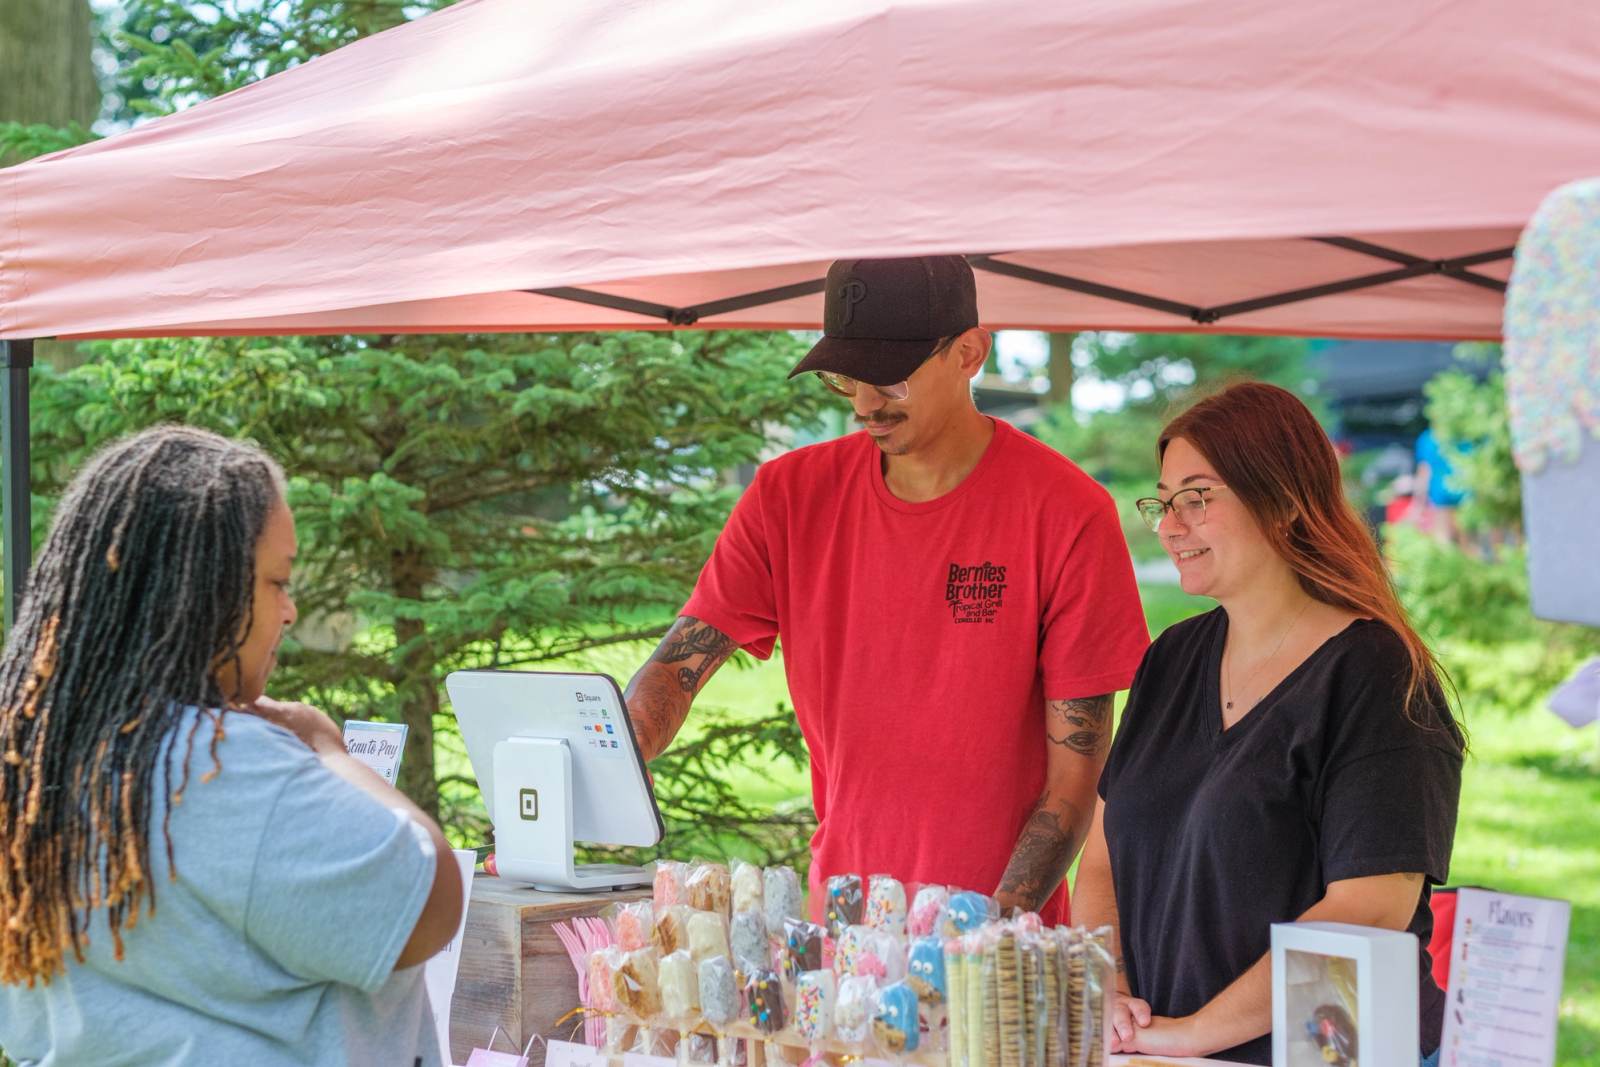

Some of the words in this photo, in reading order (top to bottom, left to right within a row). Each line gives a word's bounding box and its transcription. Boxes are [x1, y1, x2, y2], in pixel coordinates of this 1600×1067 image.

[945, 583, 1007, 600] Brother
[966, 609, 980, 617] and
[982, 608, 997, 617] Bar
[346, 738, 368, 754] Scan
[367, 739, 377, 755] to
[377, 740, 399, 759] Pay
